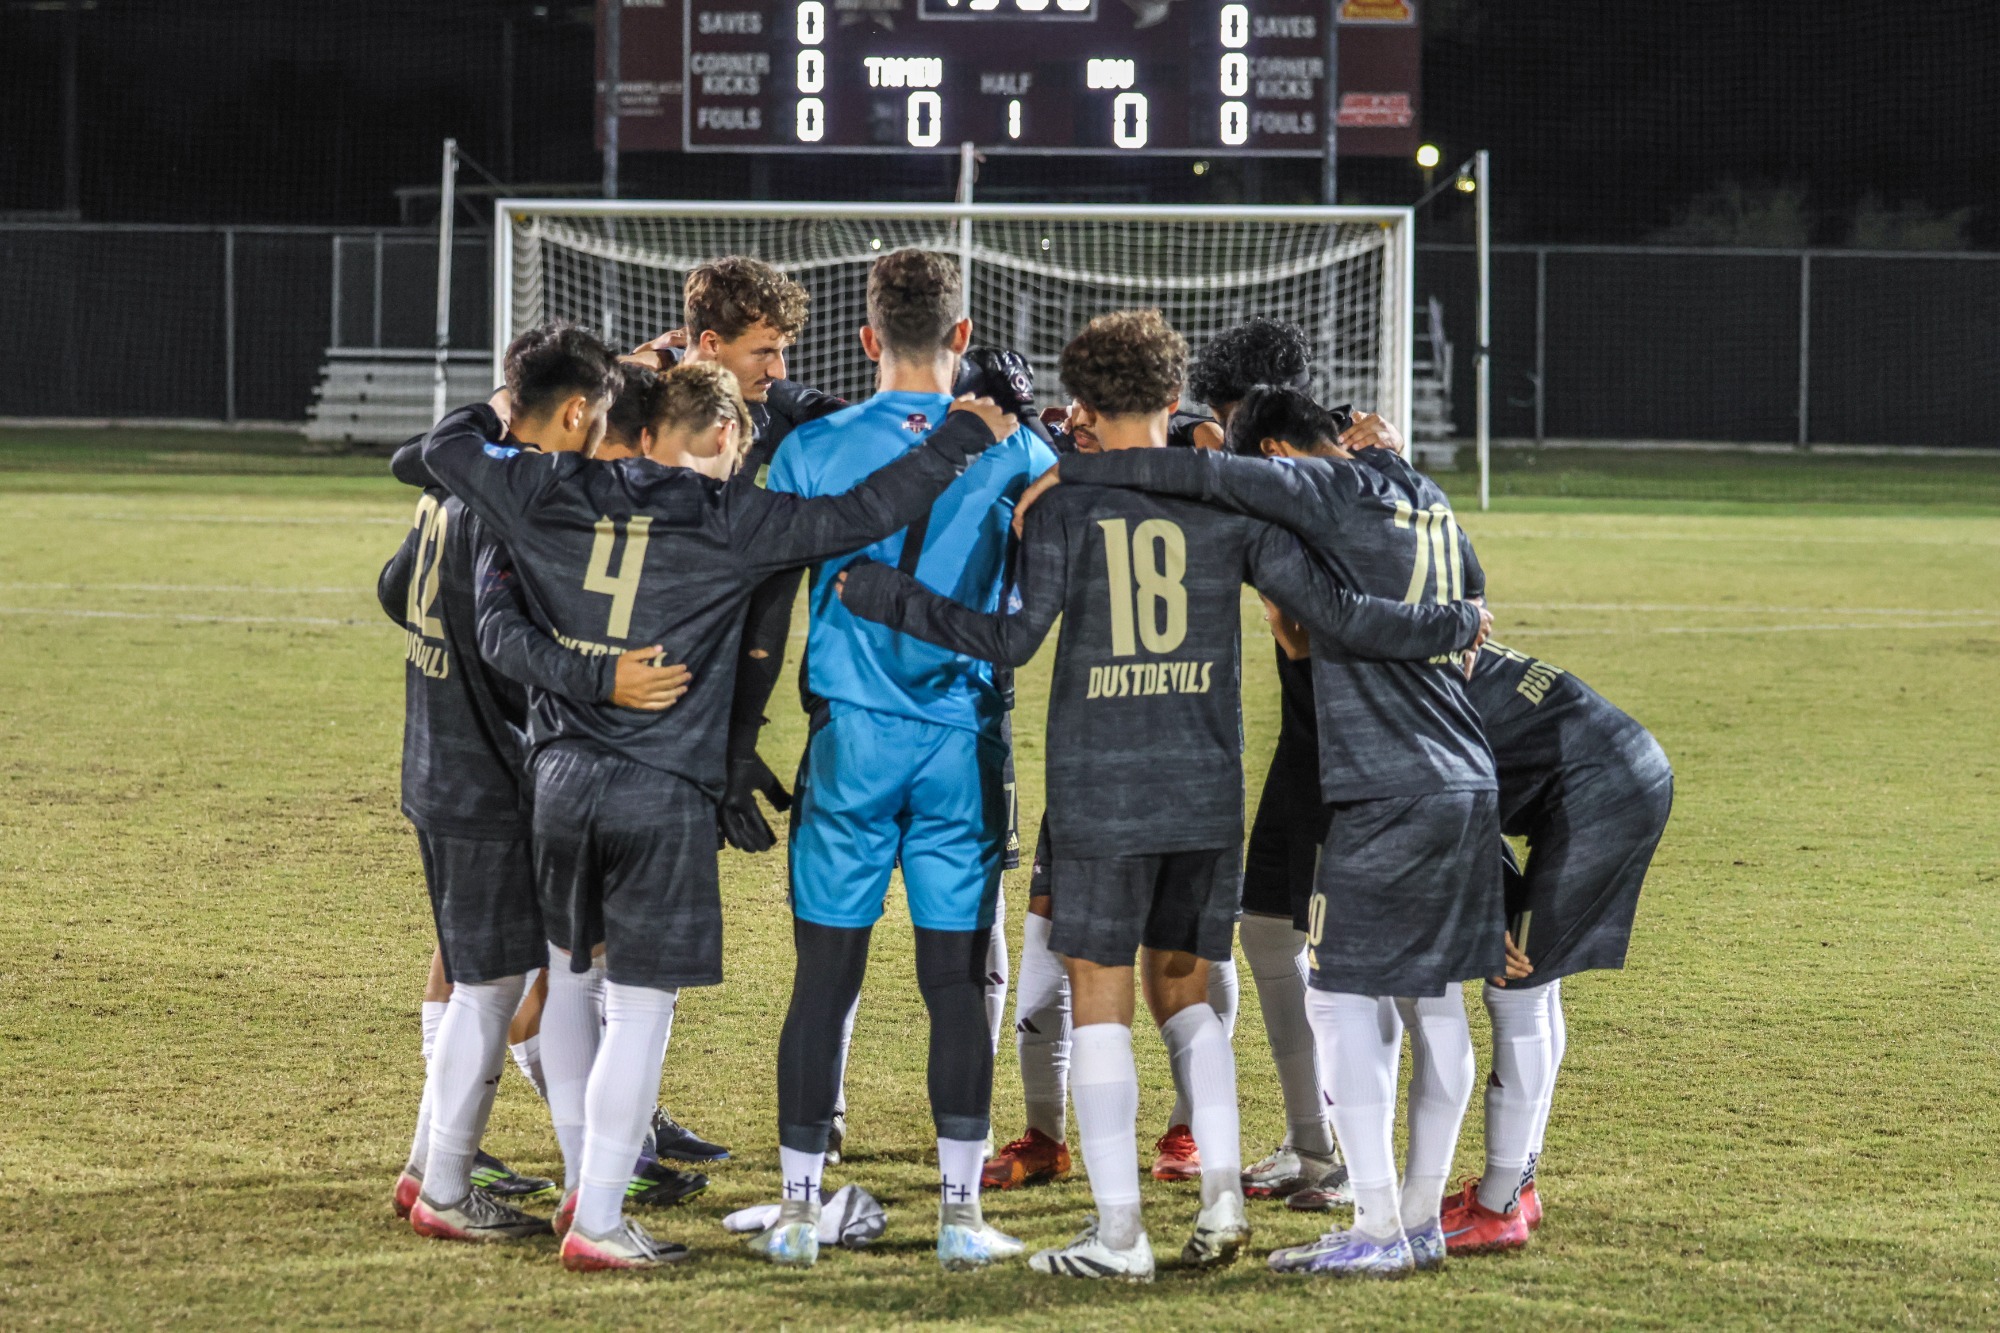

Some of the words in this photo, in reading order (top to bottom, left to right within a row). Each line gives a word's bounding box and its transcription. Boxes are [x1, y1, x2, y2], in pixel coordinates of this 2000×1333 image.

[699, 11, 763, 34] SAVES
[797, 1, 825, 45] 0
[1220, 4, 1248, 48] 0
[1253, 15, 1316, 38] SAVES
[691, 53, 770, 74] CORNER
[797, 49, 825, 93] 0
[980, 72, 1032, 94] HALF
[1220, 52, 1248, 97] 0
[1249, 57, 1324, 79] CORNER
[702, 75, 760, 95] KICKS
[1256, 80, 1314, 100] KICKS
[698, 106, 762, 129] FOULS
[797, 97, 824, 142] 0
[907, 91, 942, 147] 0
[1008, 100, 1021, 139] 1
[1113, 92, 1148, 149] 0
[1220, 101, 1248, 145] 0
[1251, 111, 1316, 134] FOULS
[583, 514, 654, 639] 4
[1097, 518, 1188, 657] 18
[1086, 661, 1214, 700] DUSTDEVILS
